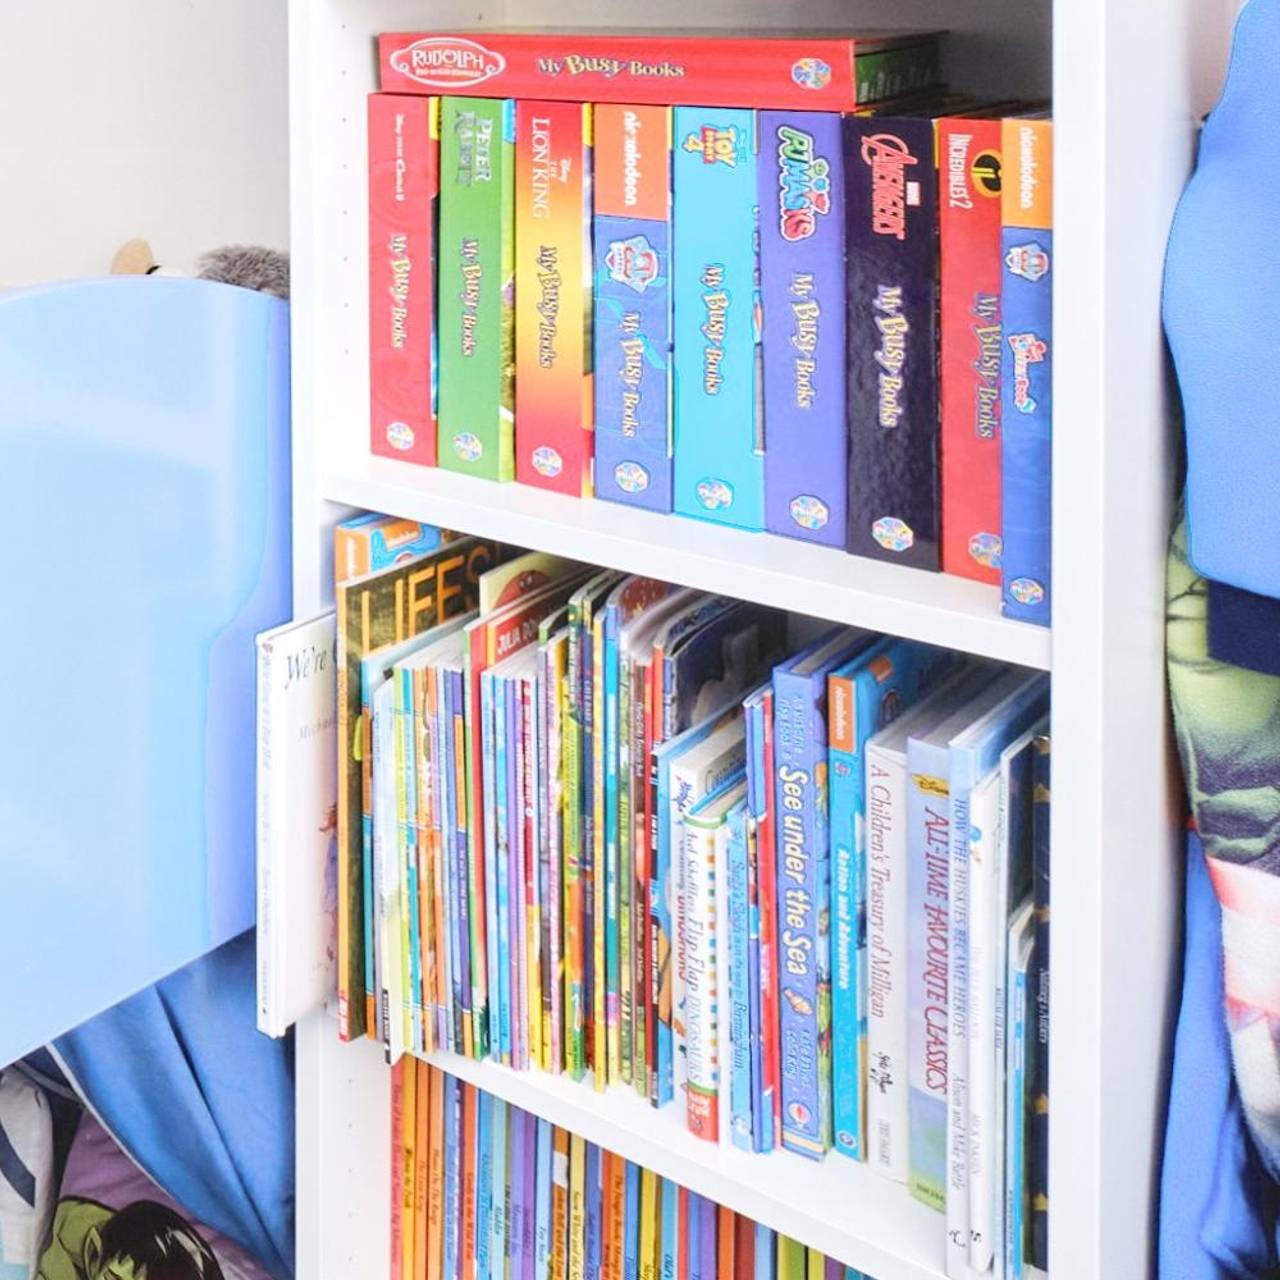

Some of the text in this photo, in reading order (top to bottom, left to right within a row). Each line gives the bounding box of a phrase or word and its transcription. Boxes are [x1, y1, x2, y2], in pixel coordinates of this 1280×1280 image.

[411, 48, 486, 68] RUDOLPH
[538, 53, 686, 78] My Busy Books
[473, 119, 493, 182] PETER
[531, 118, 550, 219] LION KING
[548, 161, 558, 178] THE
[683, 133, 703, 153] 4
[714, 129, 736, 167] TOY
[948, 133, 972, 209] INCREDIBLES 2
[1019, 127, 1034, 209] nickelodeon
[860, 134, 918, 240] AVENGERS
[390, 234, 411, 348] My Busy Books
[461, 239, 482, 357] My Busy Books
[537, 246, 560, 369] My Busy Books
[701, 263, 728, 395] My Busy Books
[792, 274, 819, 409] My Busy Books
[874, 286, 909, 428] My Busy Books
[621, 312, 644, 437] My Busy Books
[971, 293, 1002, 438] My Busy Books
[497, 625, 521, 655] JULIA
[779, 769, 811, 810] See
[782, 815, 808, 879] under
[784, 891, 810, 927] the
[835, 849, 852, 989] Action and Adventure
[867, 764, 891, 1018] A Children's Treasury of Milligan
[953, 798, 967, 1039] HOW THE HUSKIES BECAME HEROES
[683, 918, 705, 953] Flip
[785, 931, 814, 975] Sea
[922, 805, 949, 1095] ALL-TIME FAVOURITE CLASSICS
[685, 955, 705, 992] Flap
[687, 996, 704, 1082] DINOSAURS
[731, 1000, 748, 1069] Birmingham
[952, 1107, 965, 1129] and
[952, 1131, 966, 1159] Mike
[572, 1238, 580, 1255] and
[665, 1254, 673, 1278] Olaf's
